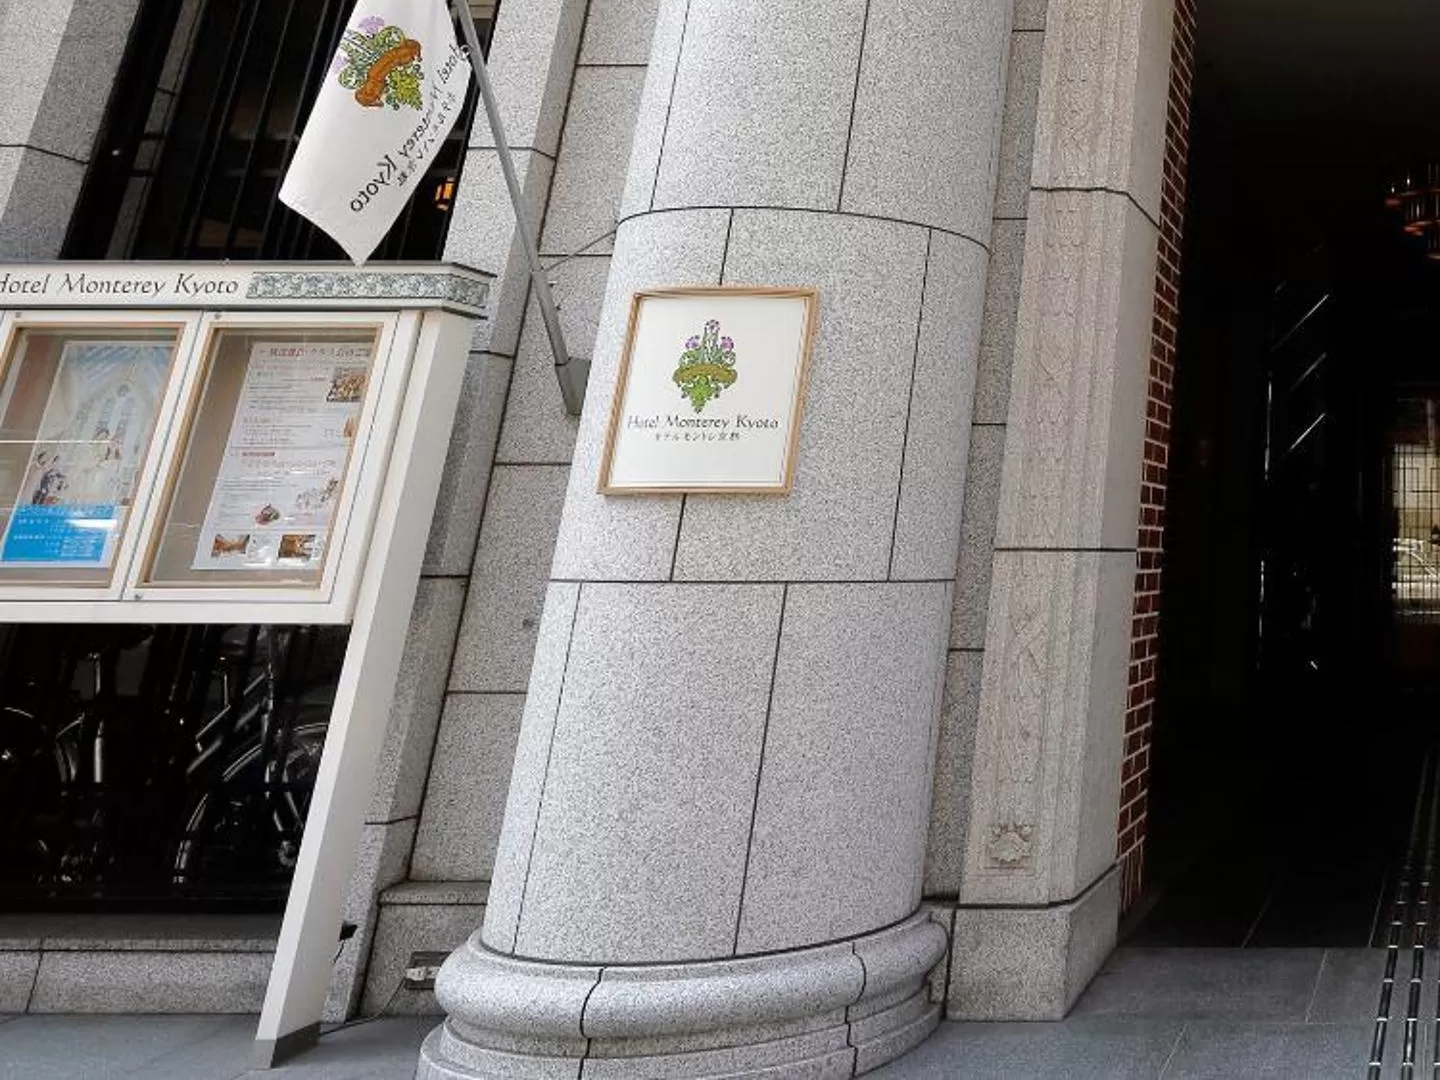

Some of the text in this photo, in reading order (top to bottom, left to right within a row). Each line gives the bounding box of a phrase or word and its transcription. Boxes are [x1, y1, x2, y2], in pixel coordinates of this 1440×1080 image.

[57, 272, 166, 298] Monterey
[174, 272, 239, 298] Kyoto
[626, 414, 779, 431] Hotel Monterey Kyoto
